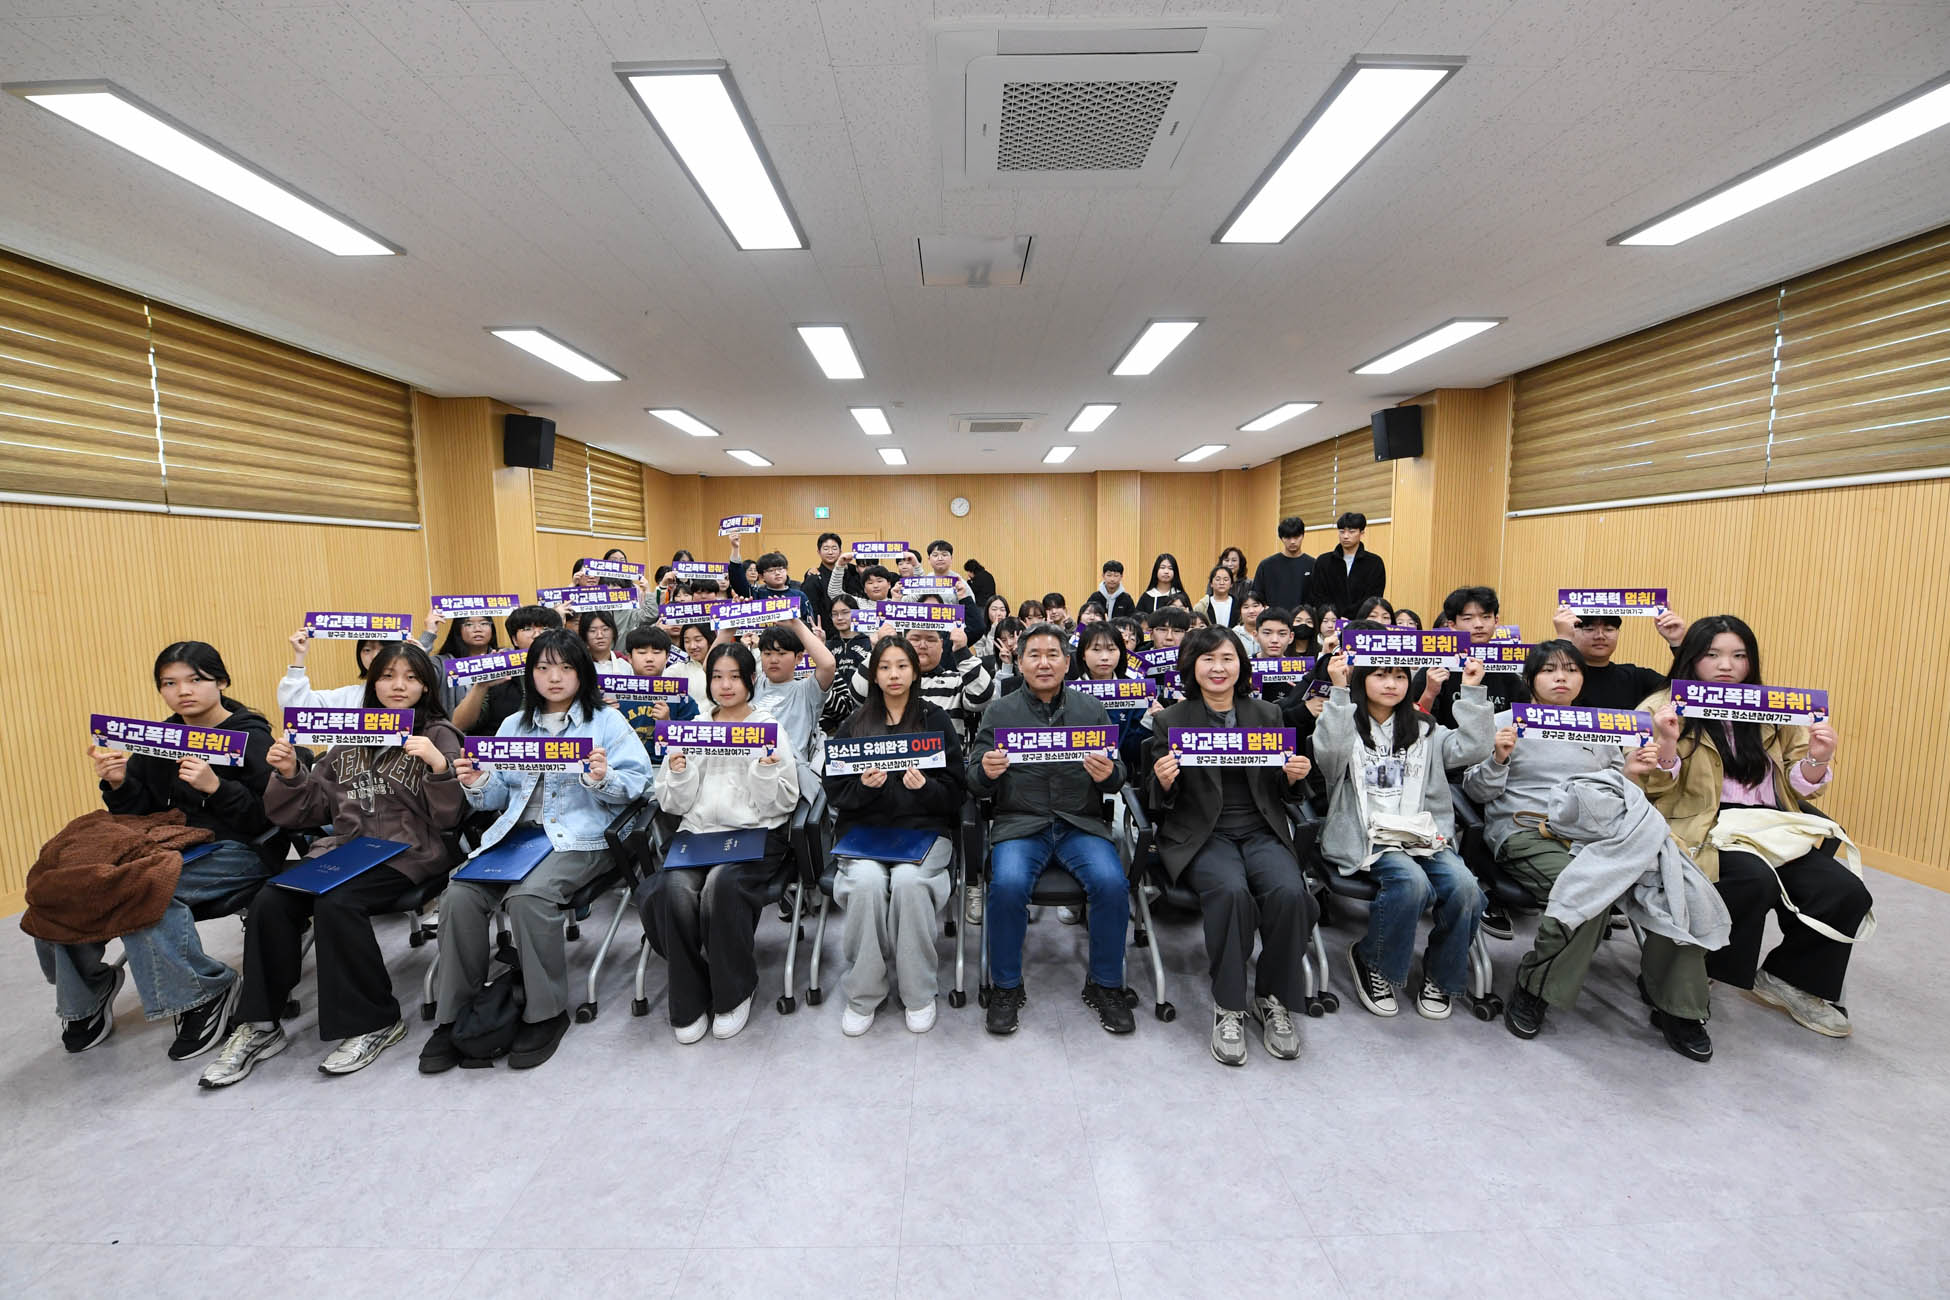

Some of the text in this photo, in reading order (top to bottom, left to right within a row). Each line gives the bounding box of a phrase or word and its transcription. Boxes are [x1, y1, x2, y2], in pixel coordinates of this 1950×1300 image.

[440, 597, 511, 609] 학교폭력 멈춰!
[569, 591, 607, 603] 학교폭력
[1568, 592, 1656, 605] 학교폭력 멈춰!
[665, 604, 702, 617] 학교폭력
[718, 602, 762, 618] 학교폭력
[765, 599, 791, 612] 멈춰!
[885, 604, 956, 620] 학교폭력 멈춰!
[315, 615, 401, 630] 학교폭력 멈춰!
[858, 612, 876, 622] 학교
[1491, 629, 1511, 639] 춰!
[1355, 634, 1458, 653] 학교폭력 멈춰!
[1145, 649, 1179, 665] 학교폭
[1470, 647, 1498, 660] 폭력
[455, 656, 507, 673] 학교폭력
[1126, 652, 1143, 672] 춰!
[1251, 660, 1306, 673] 교폭력 멈춰!
[1370, 657, 1391, 665] 양구군
[604, 677, 679, 693] 학교폭력 멈춰!
[1118, 682, 1146, 697] 멈춰!
[1687, 685, 1812, 710] 학교폭력 멈춰!
[297, 712, 400, 730] 학교폭력 멈춰!
[1525, 707, 1638, 731] 학교폭력 멈춰!
[1703, 709, 1792, 723] 양구군 청소년참여기구
[106, 721, 230, 752] 학교폭력 멈춰!
[312, 735, 334, 743] 양구군
[667, 725, 765, 744] 학교폭력 멈춰!
[1007, 730, 1106, 749] 학교폭력 멈춰!
[1181, 732, 1283, 750] 학교폭력 멈춰!
[1542, 730, 1622, 743] 양구군 청소년참여기구
[125, 744, 149, 756] 양구군
[477, 741, 580, 759] 학교폭력 멈춰!
[681, 747, 703, 755] 양구군
[828, 738, 942, 759] 청소년 유해환경 OUT!
[1021, 753, 1043, 761] 양구군
[1197, 756, 1218, 764] 양구군
[494, 763, 517, 771] 양구군
[853, 762, 873, 772] 양구군
